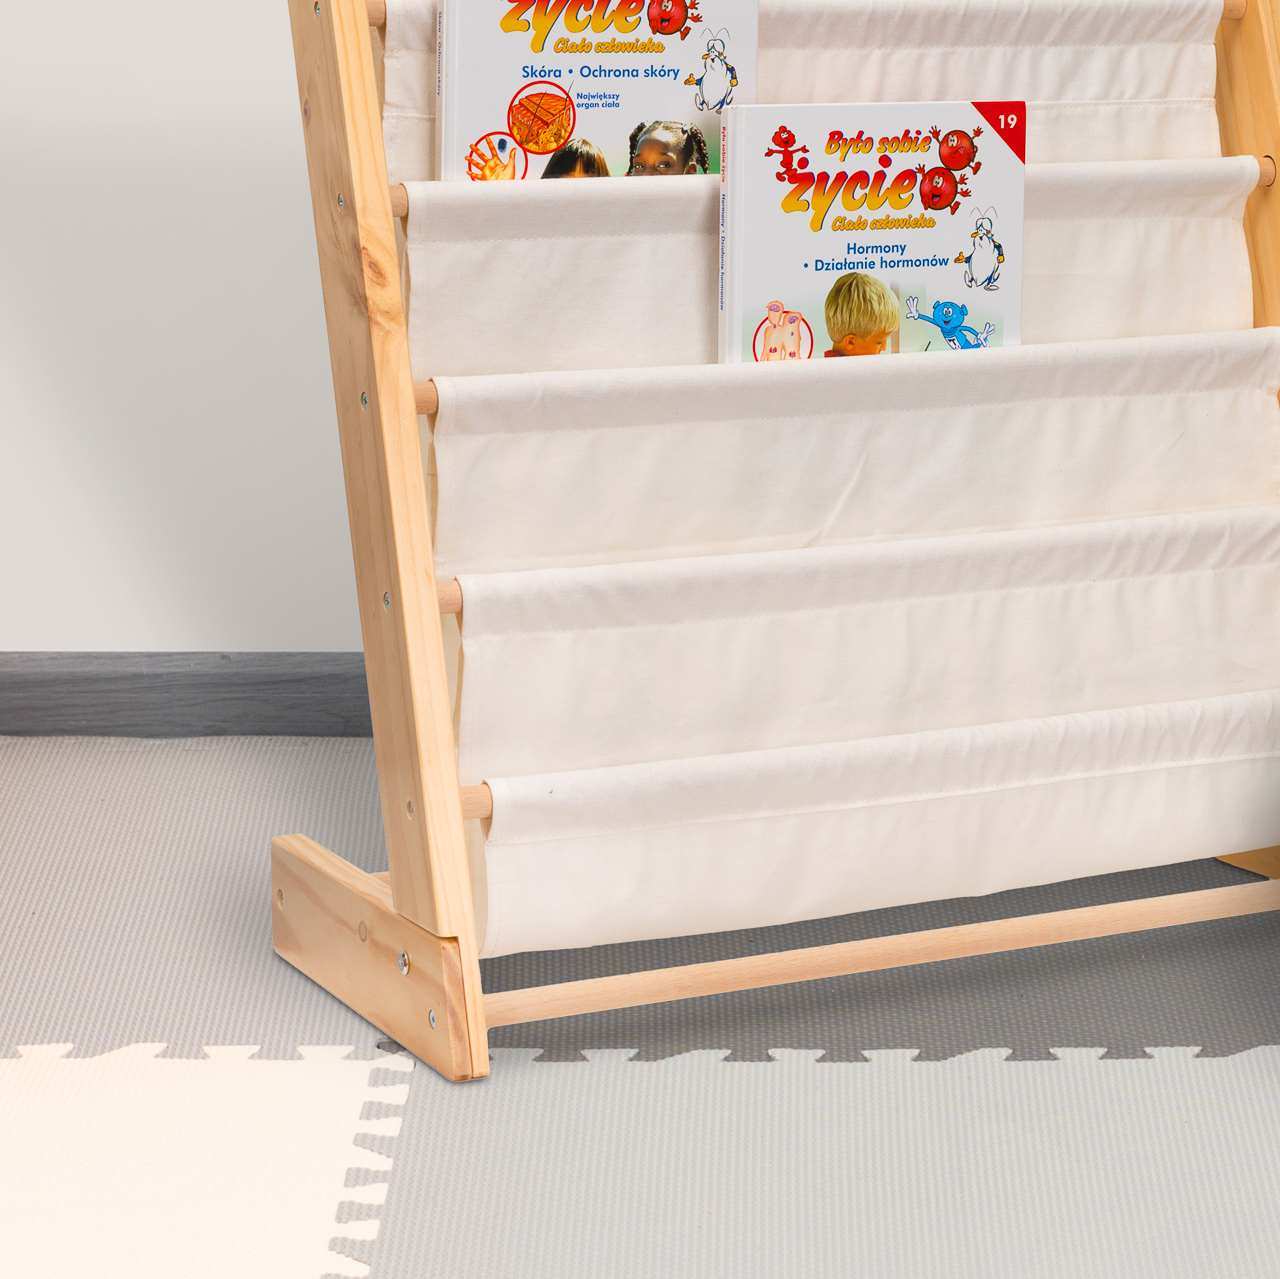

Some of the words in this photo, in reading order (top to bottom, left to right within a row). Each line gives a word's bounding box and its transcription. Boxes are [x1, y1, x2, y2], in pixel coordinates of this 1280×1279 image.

[554, 38, 592, 55] Ciało
[594, 37, 665, 54] człowieka
[522, 66, 562, 79] Skóra
[579, 65, 639, 78] Ochrona
[644, 65, 680, 80] skóry
[576, 92, 620, 101] Największy
[601, 100, 620, 108] ciała
[998, 114, 1017, 129] 19
[824, 130, 874, 162] Było
[876, 129, 932, 154] sobie
[781, 155, 918, 232] życie
[832, 214, 867, 232] Ciało
[869, 214, 935, 230] człowieka
[847, 242, 907, 256] Hormony
[814, 258, 876, 271] Działanie
[880, 256, 949, 269] hormonów
